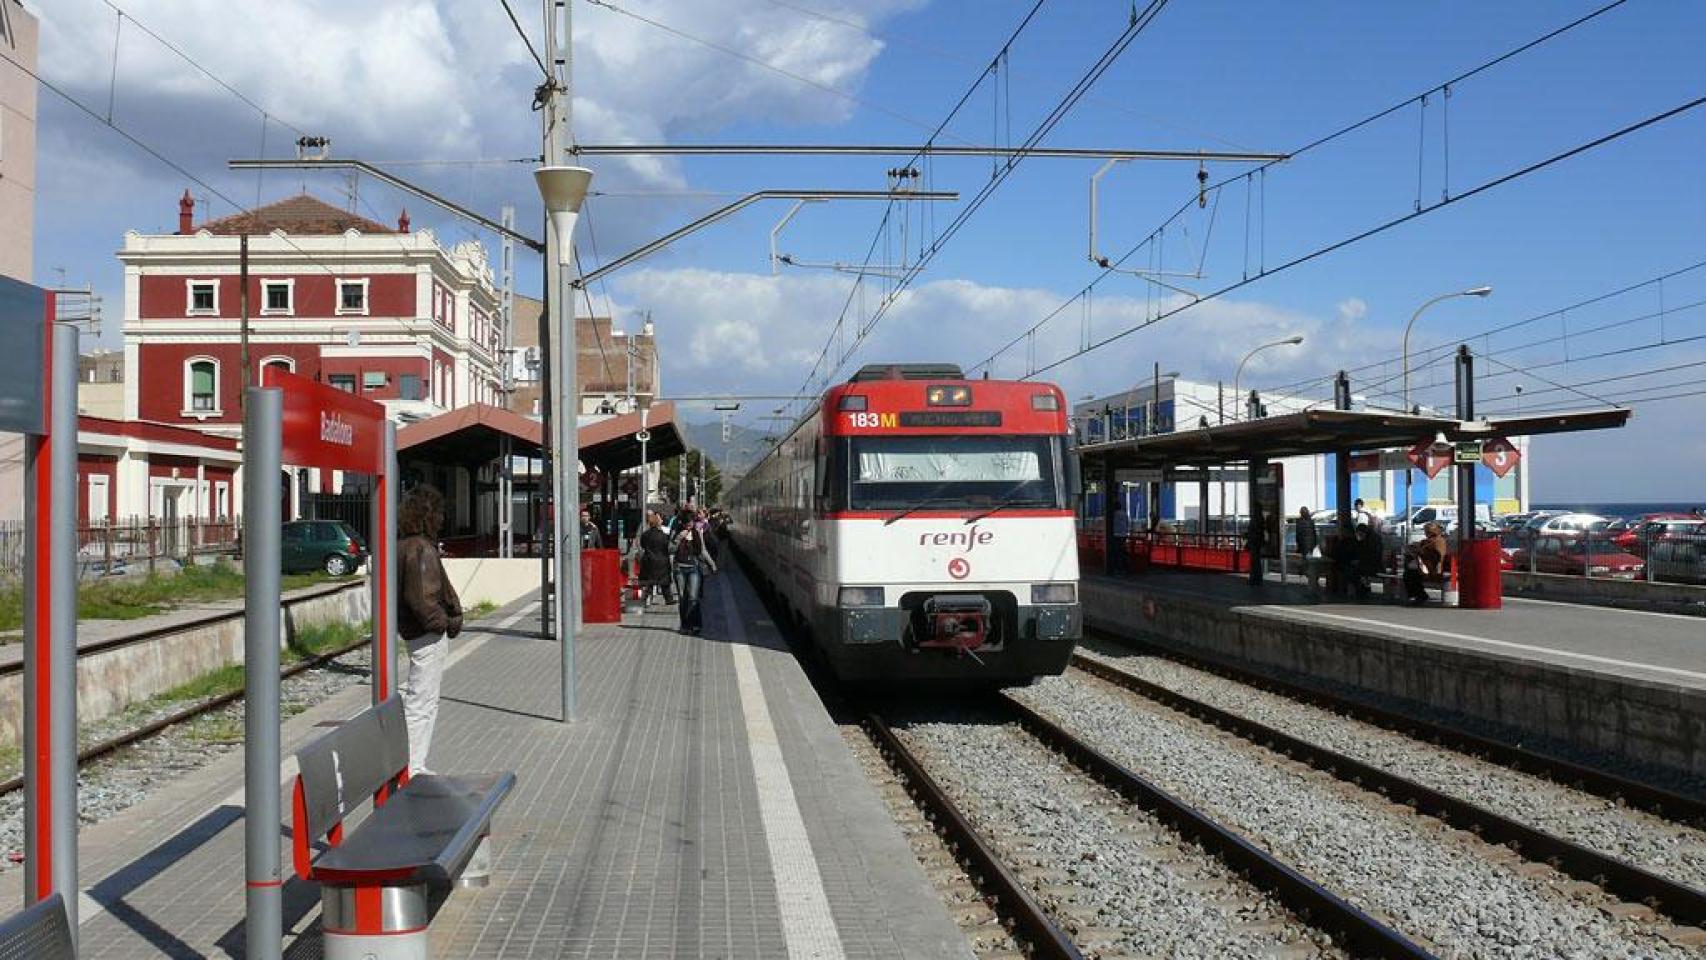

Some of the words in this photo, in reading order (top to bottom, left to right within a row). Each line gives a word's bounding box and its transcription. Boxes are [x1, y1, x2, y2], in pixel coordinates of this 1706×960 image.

[321, 410, 352, 446] Badalona
[850, 412, 896, 428] 183M
[1495, 444, 1506, 466] 3
[919, 524, 993, 552] renfe
